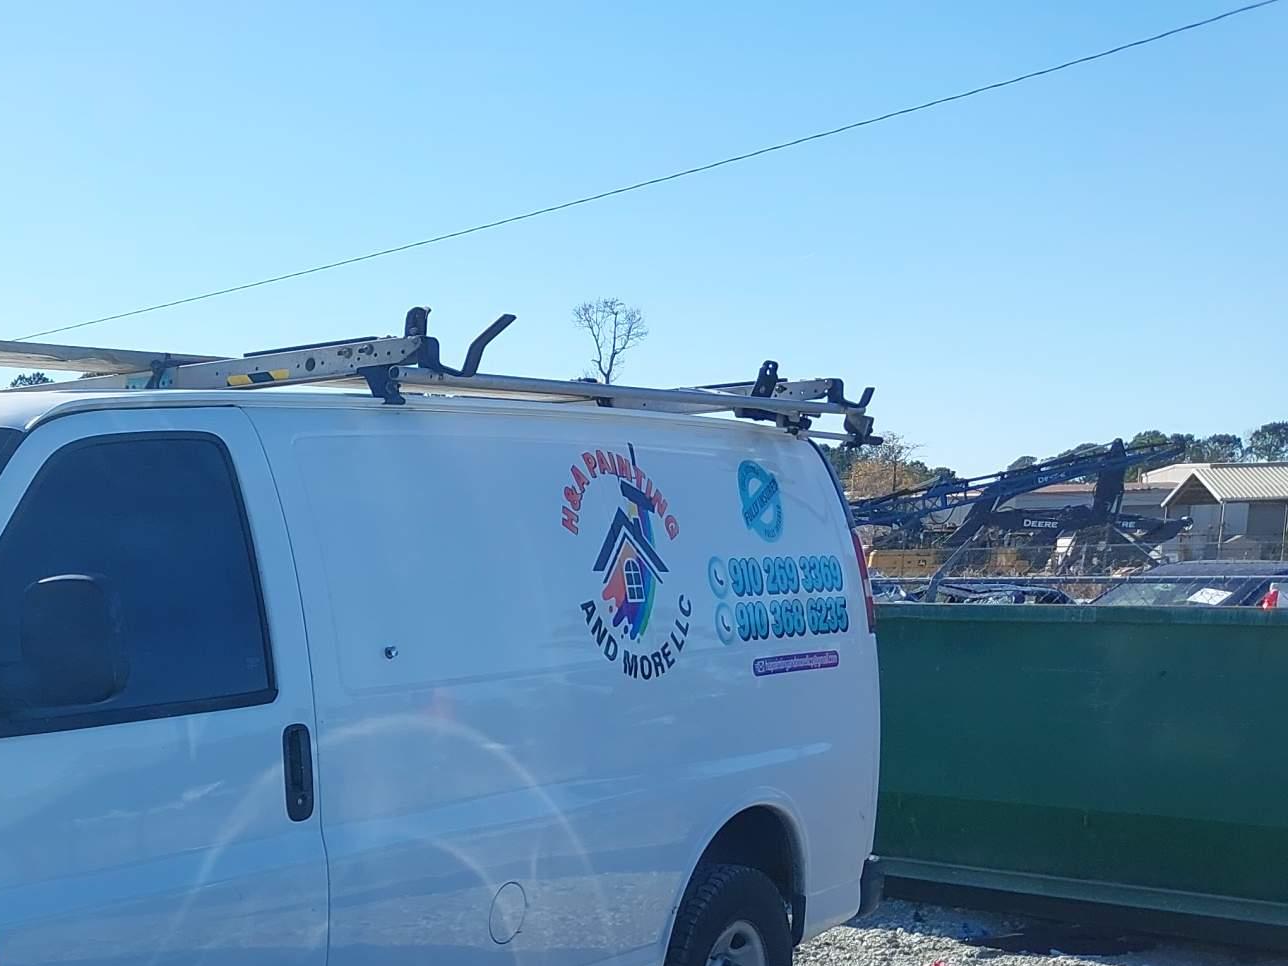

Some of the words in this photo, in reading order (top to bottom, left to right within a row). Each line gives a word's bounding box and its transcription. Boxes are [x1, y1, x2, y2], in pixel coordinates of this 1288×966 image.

[562, 464, 590, 536] H&A
[581, 450, 680, 540] PAINTING
[1023, 519, 1058, 528] DEERE
[728, 557, 764, 597] 910
[763, 556, 800, 595] 269
[799, 555, 844, 593] 3369
[580, 600, 618, 661] AND
[623, 642, 675, 680] MORE
[670, 594, 692, 652] LLC
[735, 601, 769, 641] 910
[769, 599, 807, 638] 368
[806, 597, 849, 635] 6235
